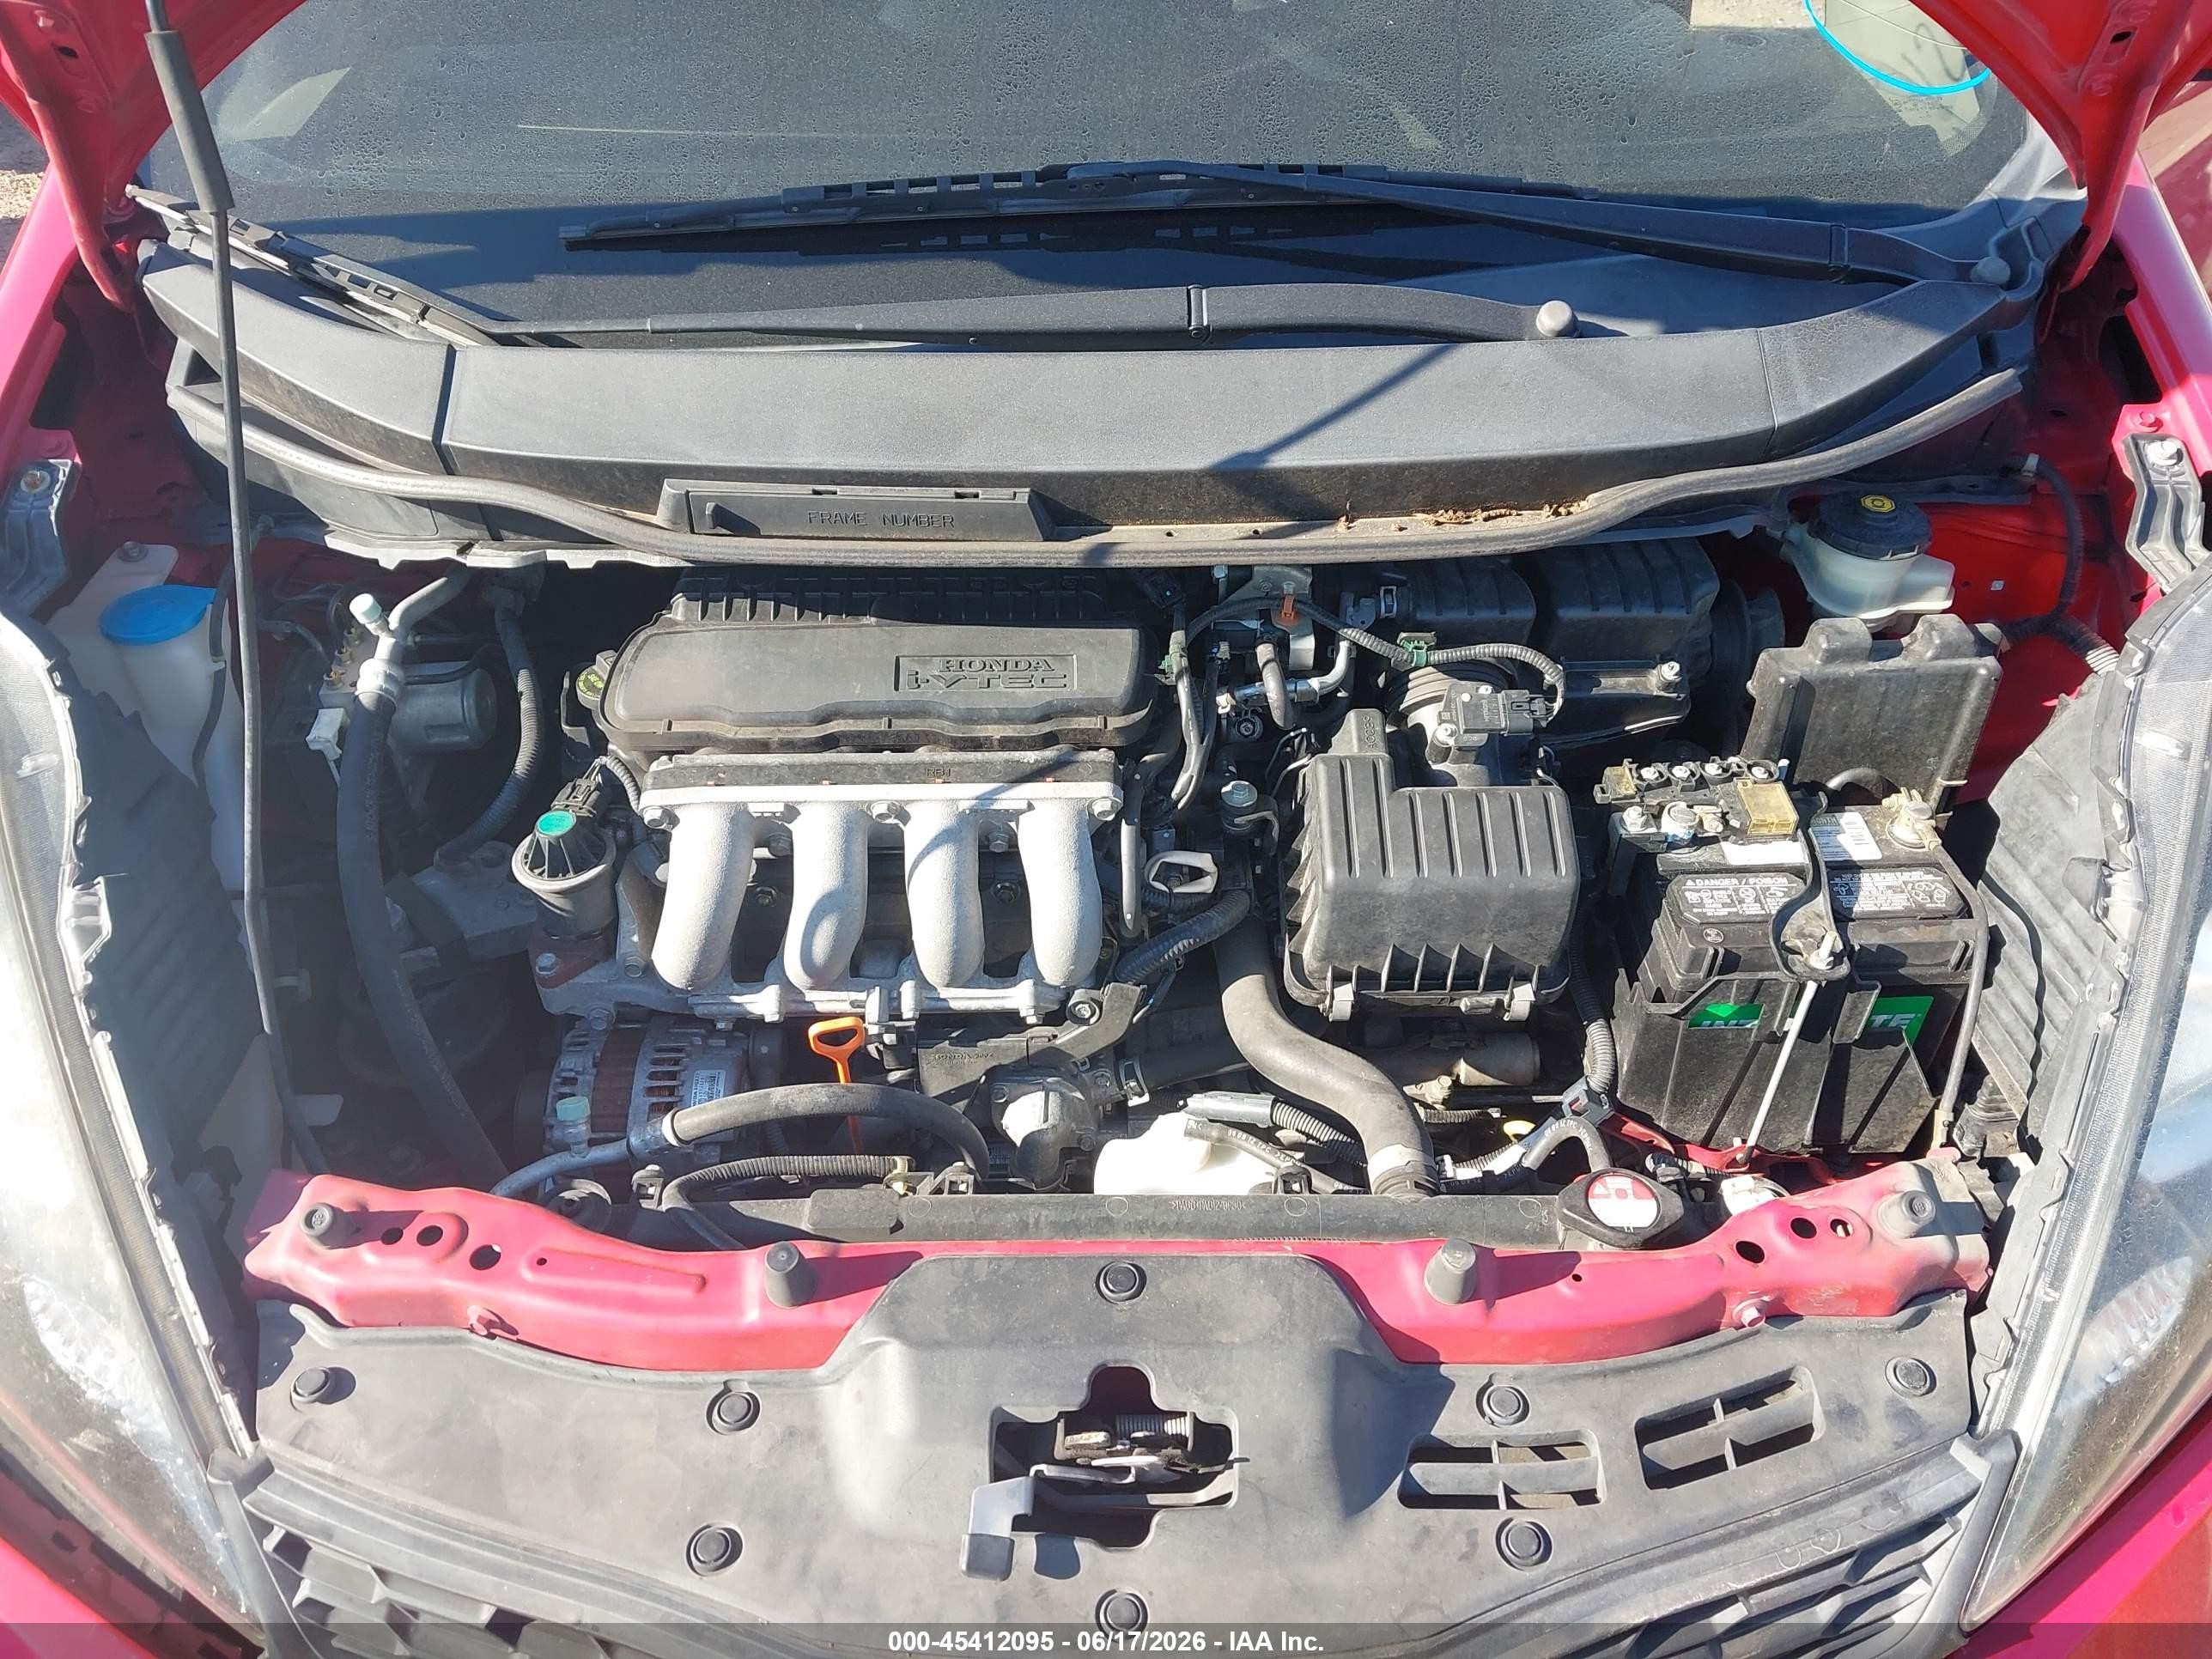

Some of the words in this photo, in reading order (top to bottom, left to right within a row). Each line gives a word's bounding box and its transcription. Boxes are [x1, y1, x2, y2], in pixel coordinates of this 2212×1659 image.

[808, 510, 867, 526] FRAME
[883, 513, 955, 528] NUMBER
[939, 659, 1055, 672] HONDA
[907, 670, 1067, 689] i-VTEC
[1748, 877, 1788, 885] POISON
